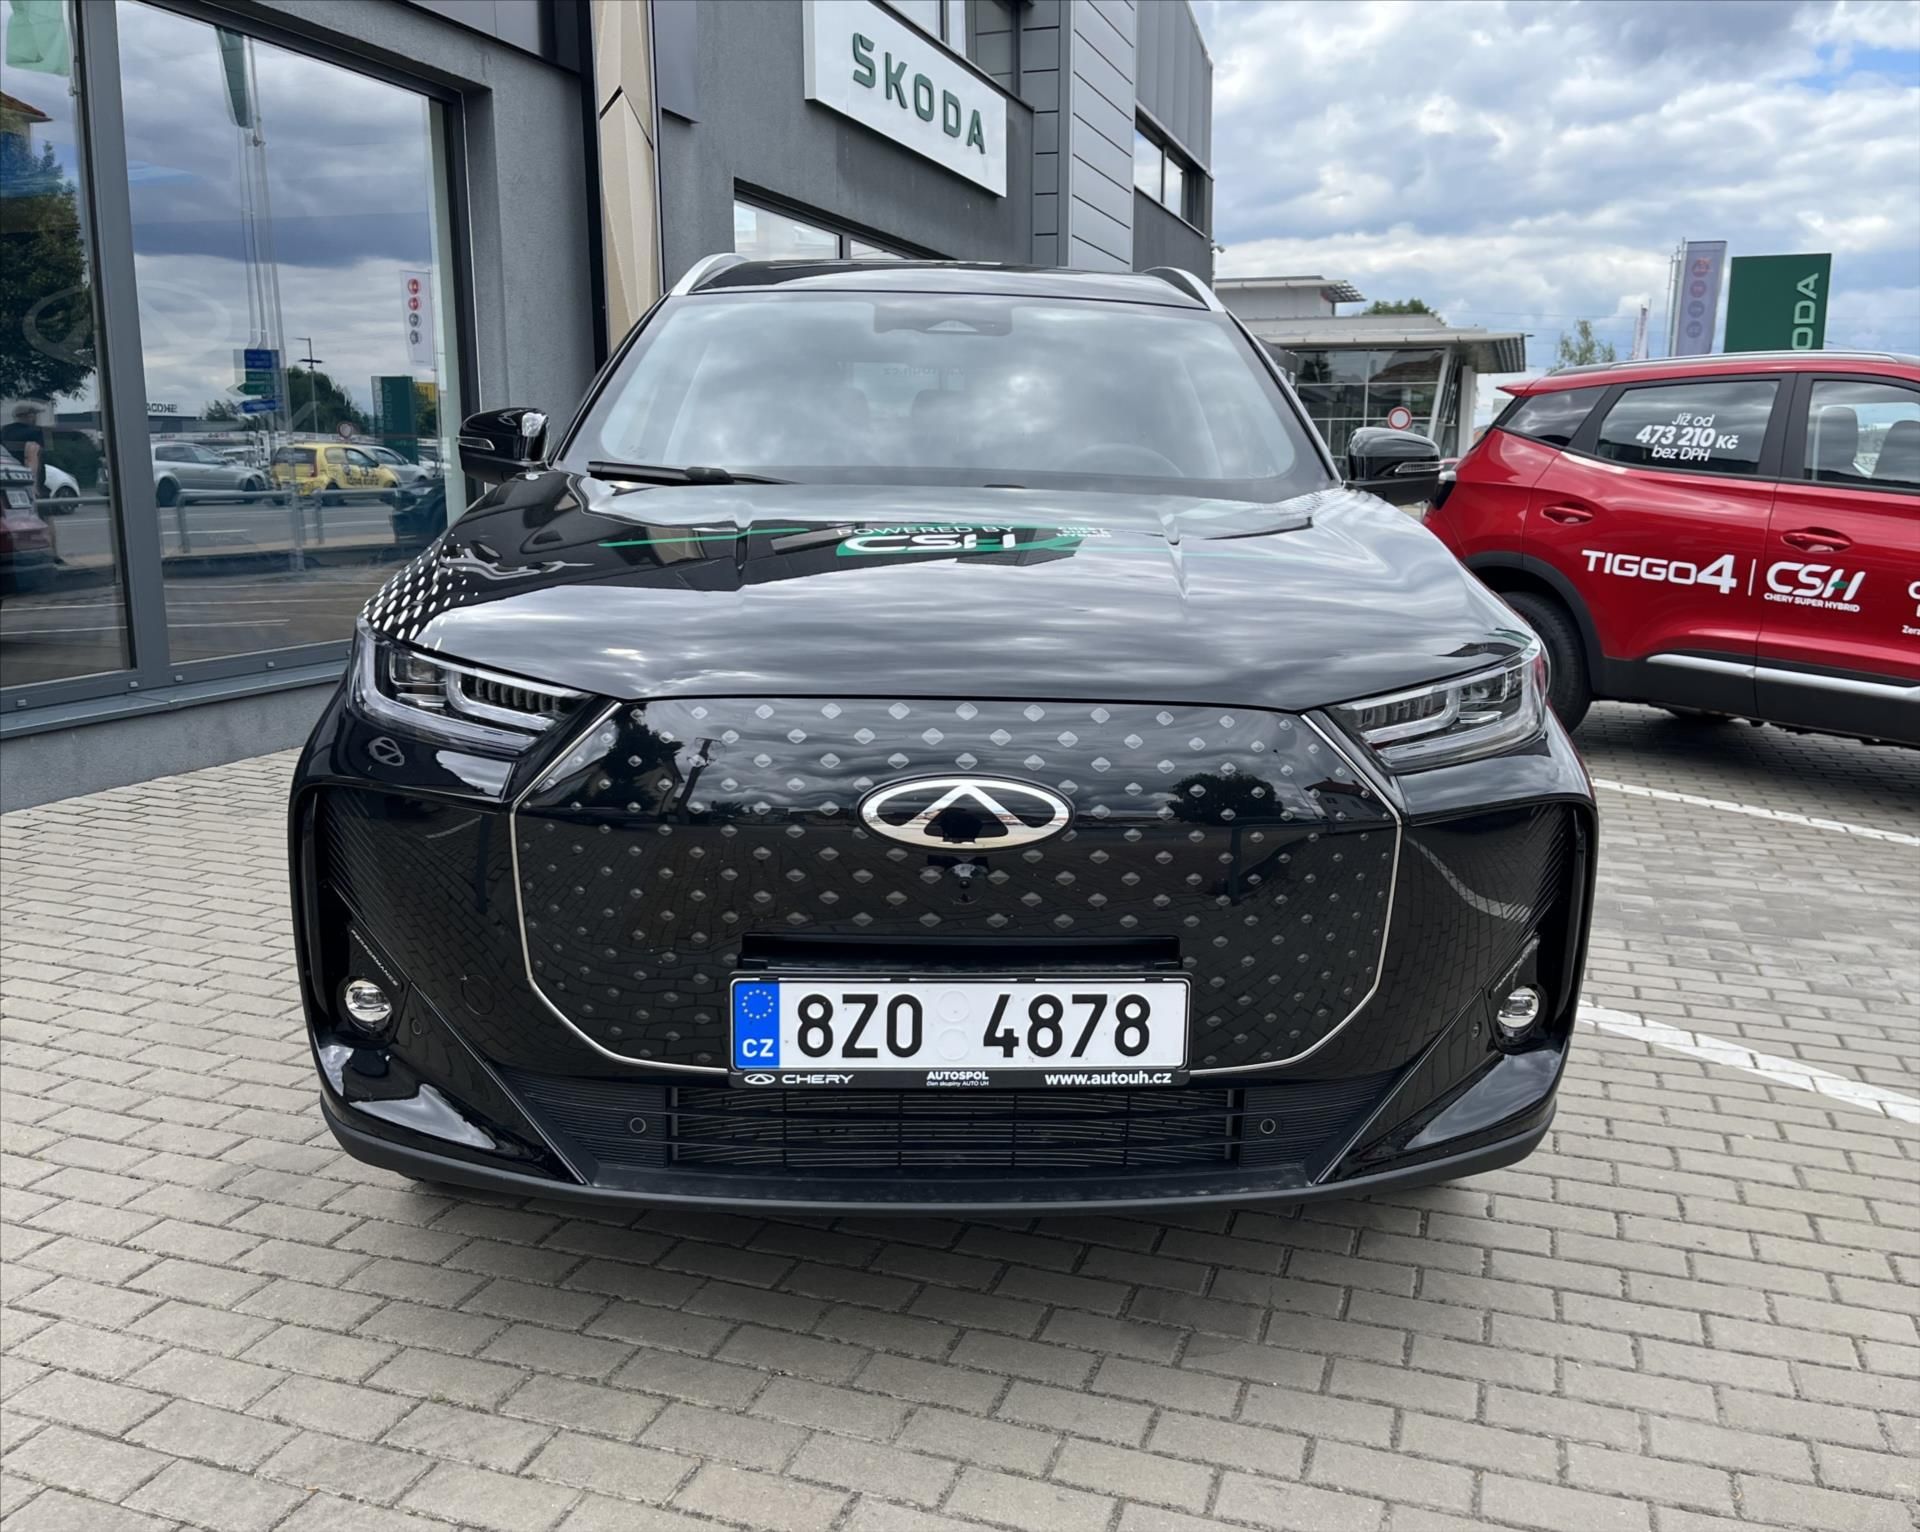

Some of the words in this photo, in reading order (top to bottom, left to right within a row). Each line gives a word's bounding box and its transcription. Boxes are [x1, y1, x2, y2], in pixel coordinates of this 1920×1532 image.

[1672, 412, 1691, 425] Již
[1693, 414, 1715, 427] od
[1635, 425, 1676, 445] 473
[1677, 427, 1716, 447] 210
[1715, 434, 1739, 449] Kč
[1651, 444, 1678, 459] bez
[1679, 447, 1711, 461] DPH
[838, 526, 972, 535] POWERED
[982, 525, 1014, 533] BY
[845, 534, 1016, 552] CSH
[1766, 561, 1866, 602] CSH
[1763, 592, 1794, 603] CHERY
[1794, 596, 1824, 608] SUPER
[1825, 600, 1860, 613] HYBRID
[982, 993, 1151, 1058] 4878
[742, 1038, 774, 1058] CZ
[781, 1074, 854, 1084] CHERY
[926, 1071, 990, 1081] AUTOSPOL
[1044, 1070, 1172, 1085] www.autouh.cz
